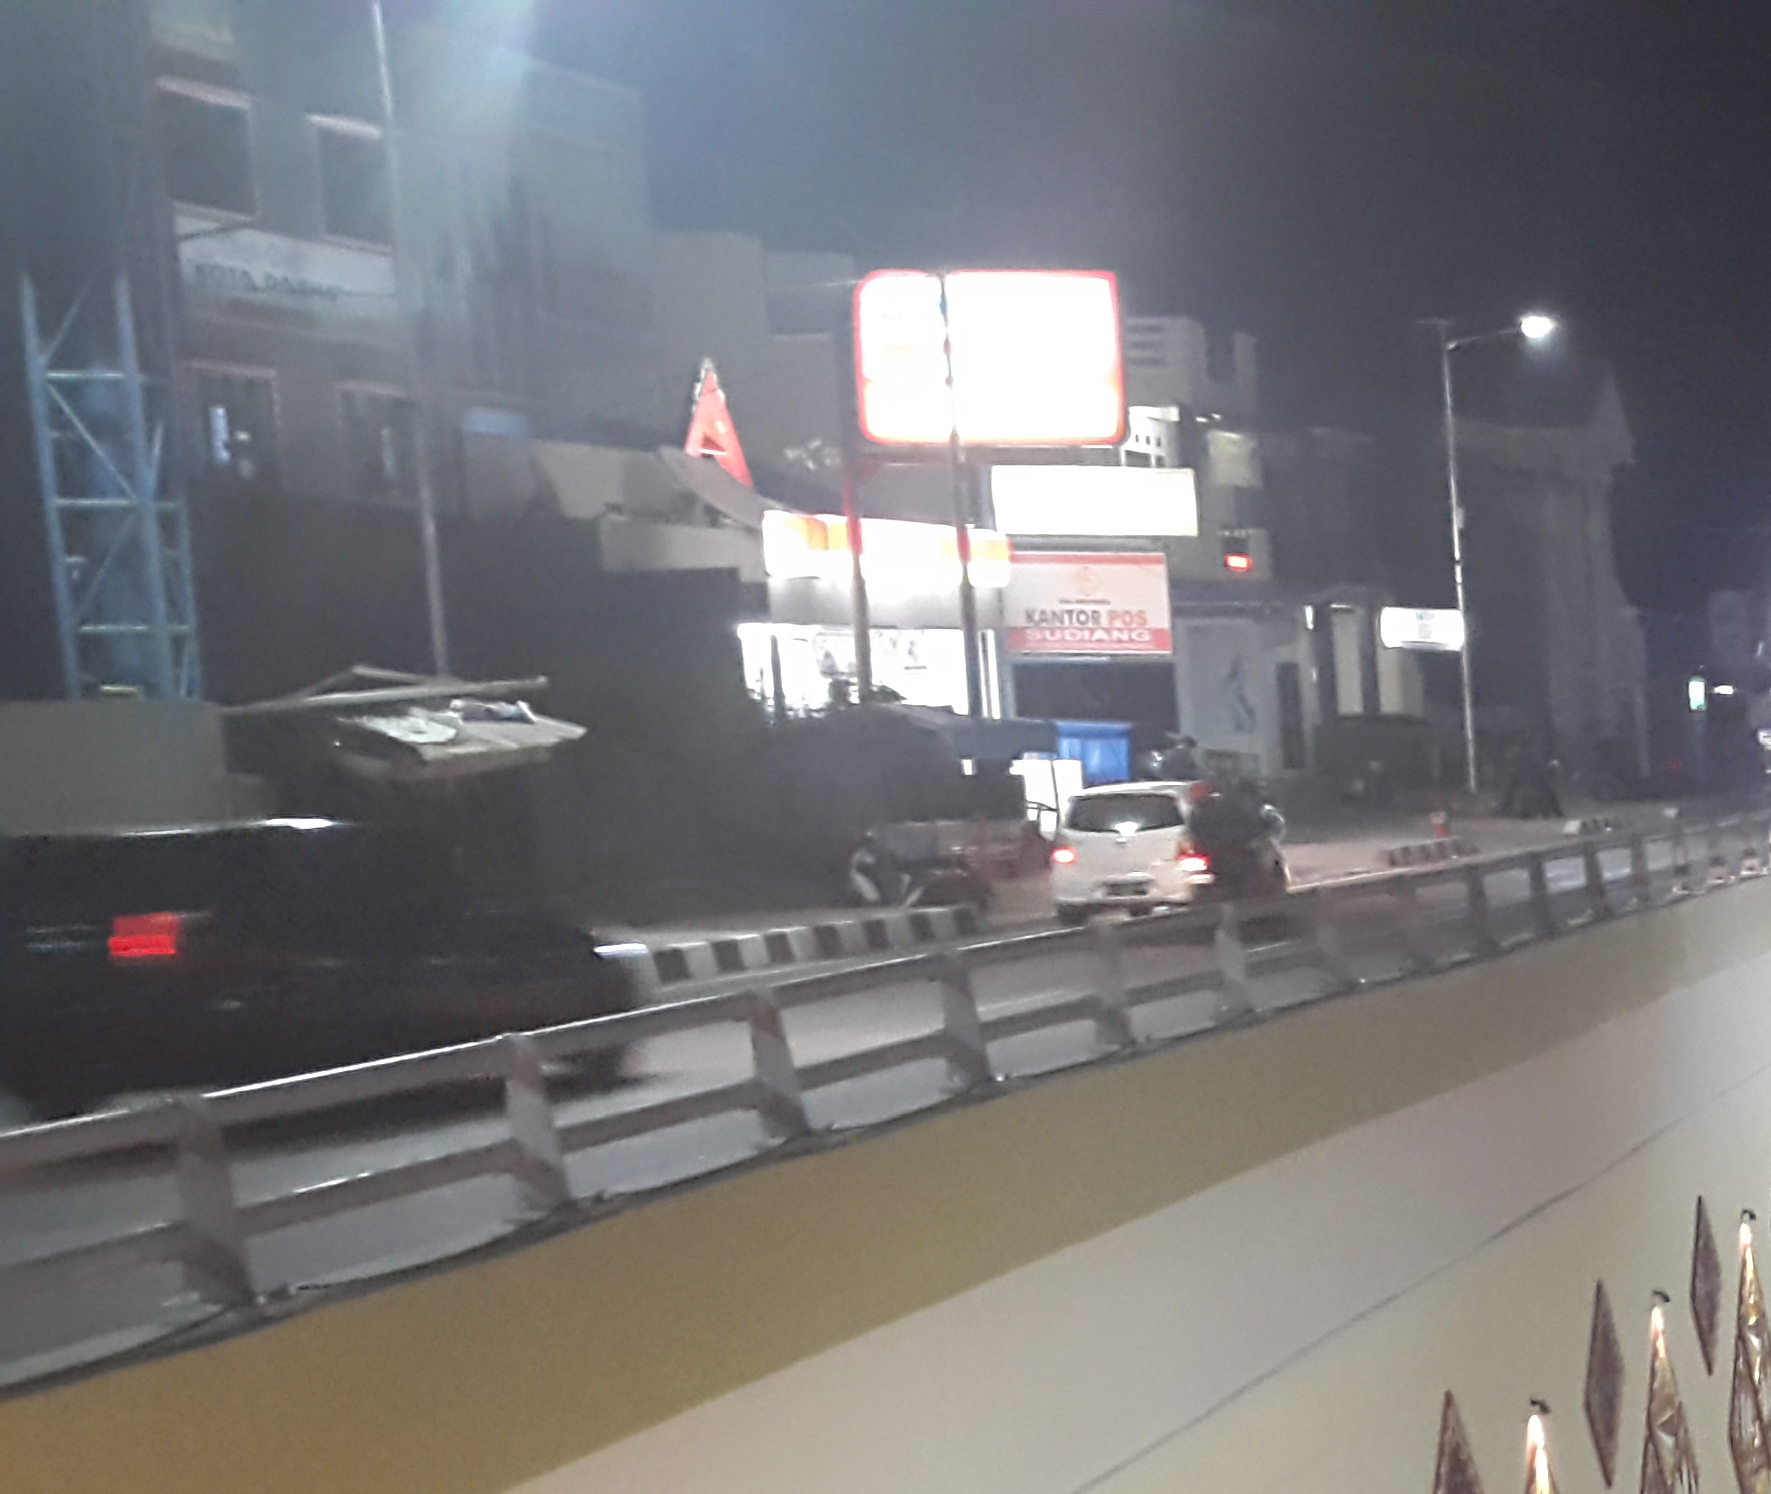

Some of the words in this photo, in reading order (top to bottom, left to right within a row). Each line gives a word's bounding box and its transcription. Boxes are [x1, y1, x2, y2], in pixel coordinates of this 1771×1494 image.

[1024, 609, 1101, 626] KANTOR
[1107, 610, 1148, 627] POS
[1025, 628, 1151, 642] SUDIANG
